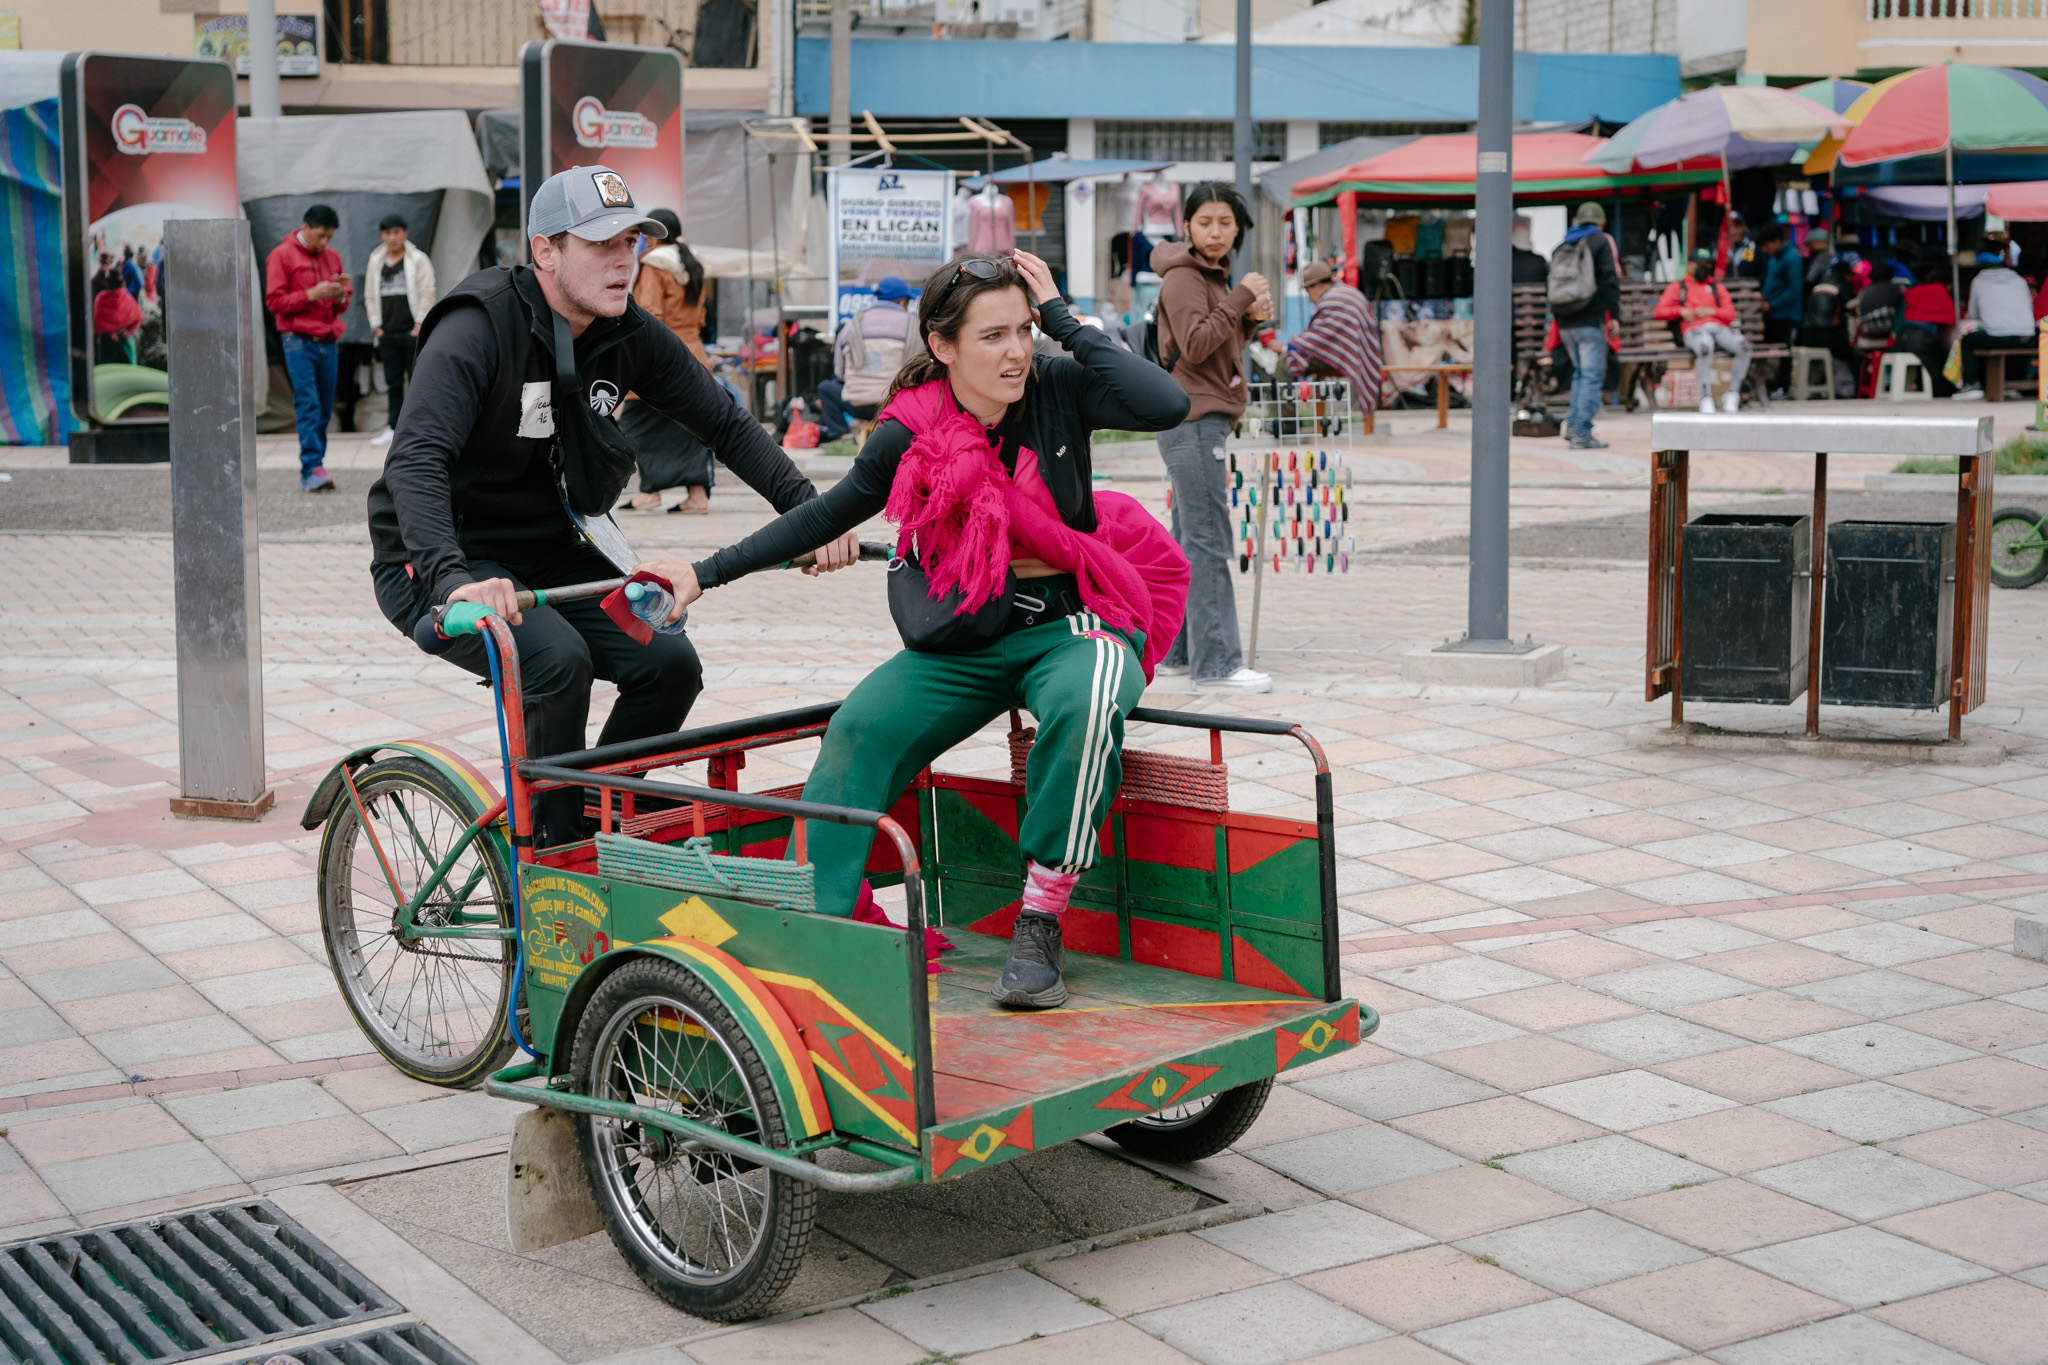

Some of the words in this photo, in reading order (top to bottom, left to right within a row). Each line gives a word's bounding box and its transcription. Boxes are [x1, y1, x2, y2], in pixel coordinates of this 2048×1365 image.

[887, 200, 941, 208] DIRECTO
[841, 207, 881, 217] VENDE
[885, 208, 941, 218] TERRENO
[842, 218, 869, 231] EN
[841, 232, 940, 243] FACTIBILIDAD
[536, 412, 548, 424] AE
[557, 878, 566, 891] DE
[566, 880, 608, 917] TRICICLEROS
[530, 897, 553, 913] unidos
[554, 900, 565, 915] por
[566, 900, 574, 915] el
[575, 905, 601, 928] cambio
